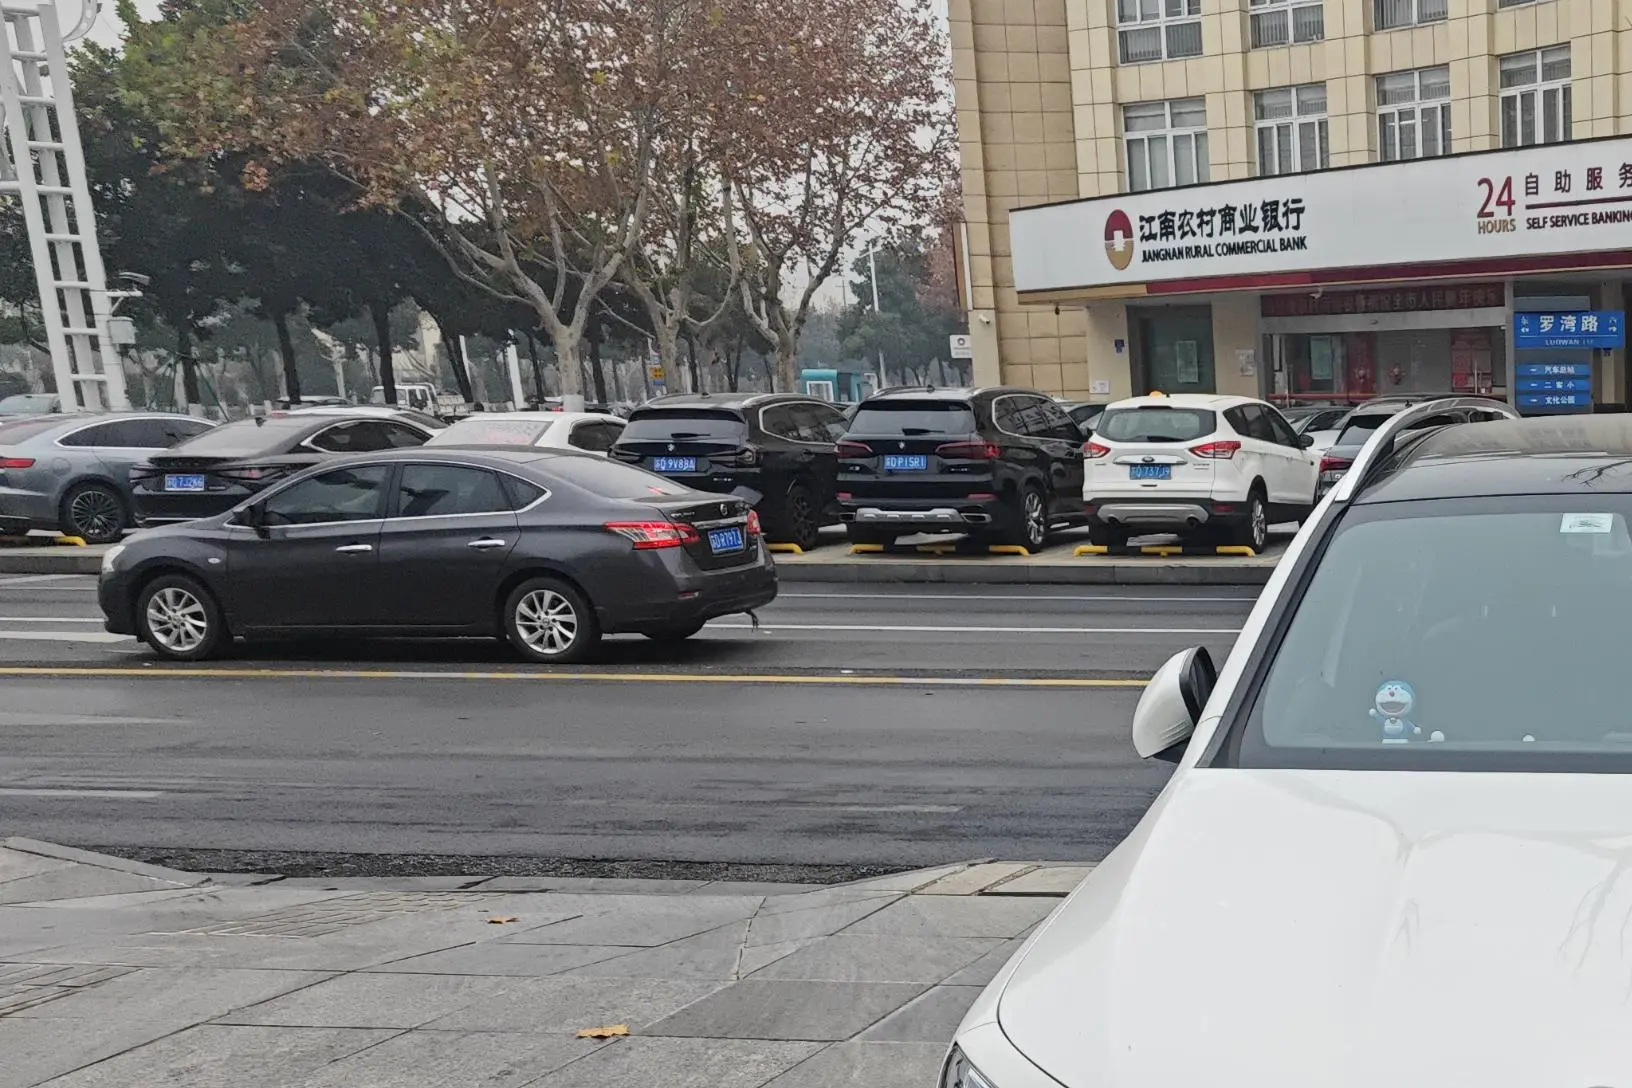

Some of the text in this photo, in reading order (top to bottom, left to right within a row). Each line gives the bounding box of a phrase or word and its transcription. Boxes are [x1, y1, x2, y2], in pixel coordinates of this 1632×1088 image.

[1476, 175, 1516, 219] 24
[1139, 198, 1306, 243] 江南农村商业银行
[1478, 218, 1516, 235] HOURS
[1526, 216, 1548, 230] SELF
[1549, 212, 1590, 228] SERVICE
[1141, 235, 1308, 263] JIANGNAN RURAL COMMERCIAL BANK
[1539, 314, 1598, 332] 罗湾路
